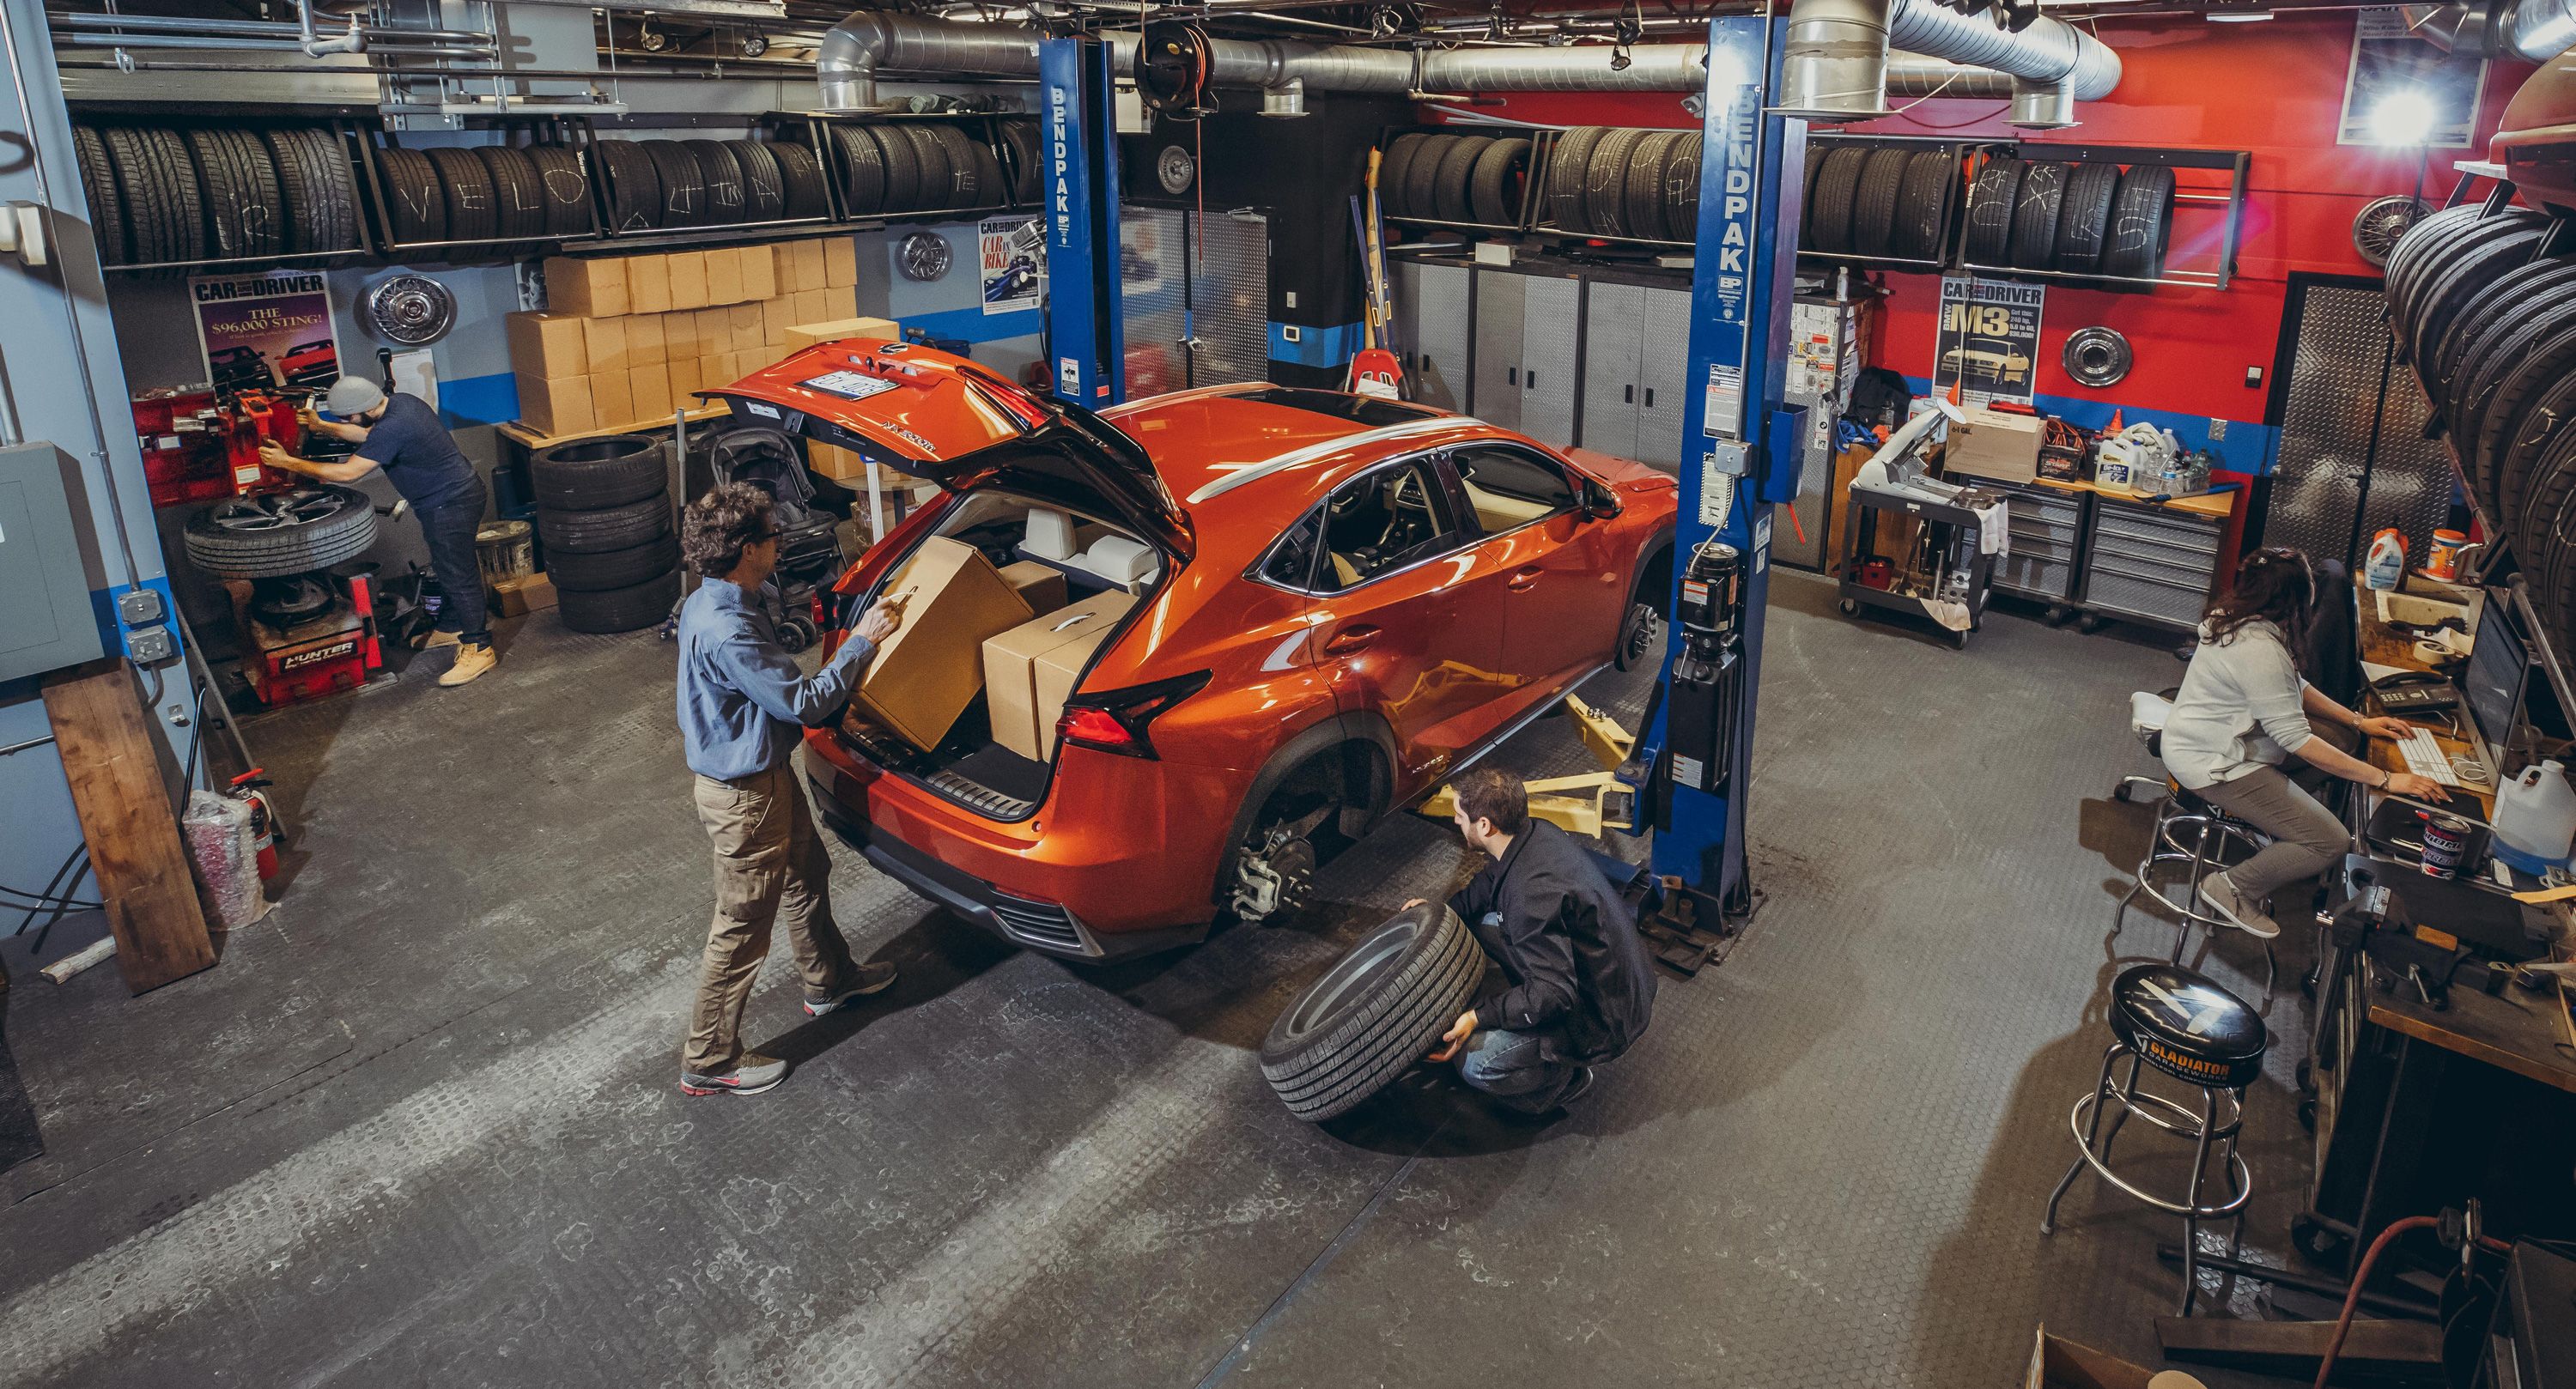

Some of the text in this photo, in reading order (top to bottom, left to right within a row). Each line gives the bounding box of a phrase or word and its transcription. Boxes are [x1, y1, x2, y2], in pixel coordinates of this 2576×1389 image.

[1051, 88, 1069, 213] BENDPAK
[1720, 89, 1755, 272] BENDPAK
[981, 222, 999, 234] CAR
[1005, 221, 1031, 233] DRIV
[982, 235, 1003, 254] CAR
[985, 252, 1009, 270] BIKE
[195, 282, 239, 301] CAR
[251, 275, 325, 296] DRIVER
[1720, 276, 1741, 288] BP
[1943, 282, 1973, 299] CAR
[1984, 285, 2042, 305] DRIVER
[211, 319, 268, 336] $96,000
[272, 313, 323, 328] STING!
[248, 307, 281, 319] THE
[1943, 304, 1953, 331] BMW
[1950, 303, 2010, 337] M3
[286, 642, 353, 665] HUNTER
[2148, 1051, 2228, 1081] GARAGEWORKS
[2150, 1041, 2231, 1076] GLADIATOR
